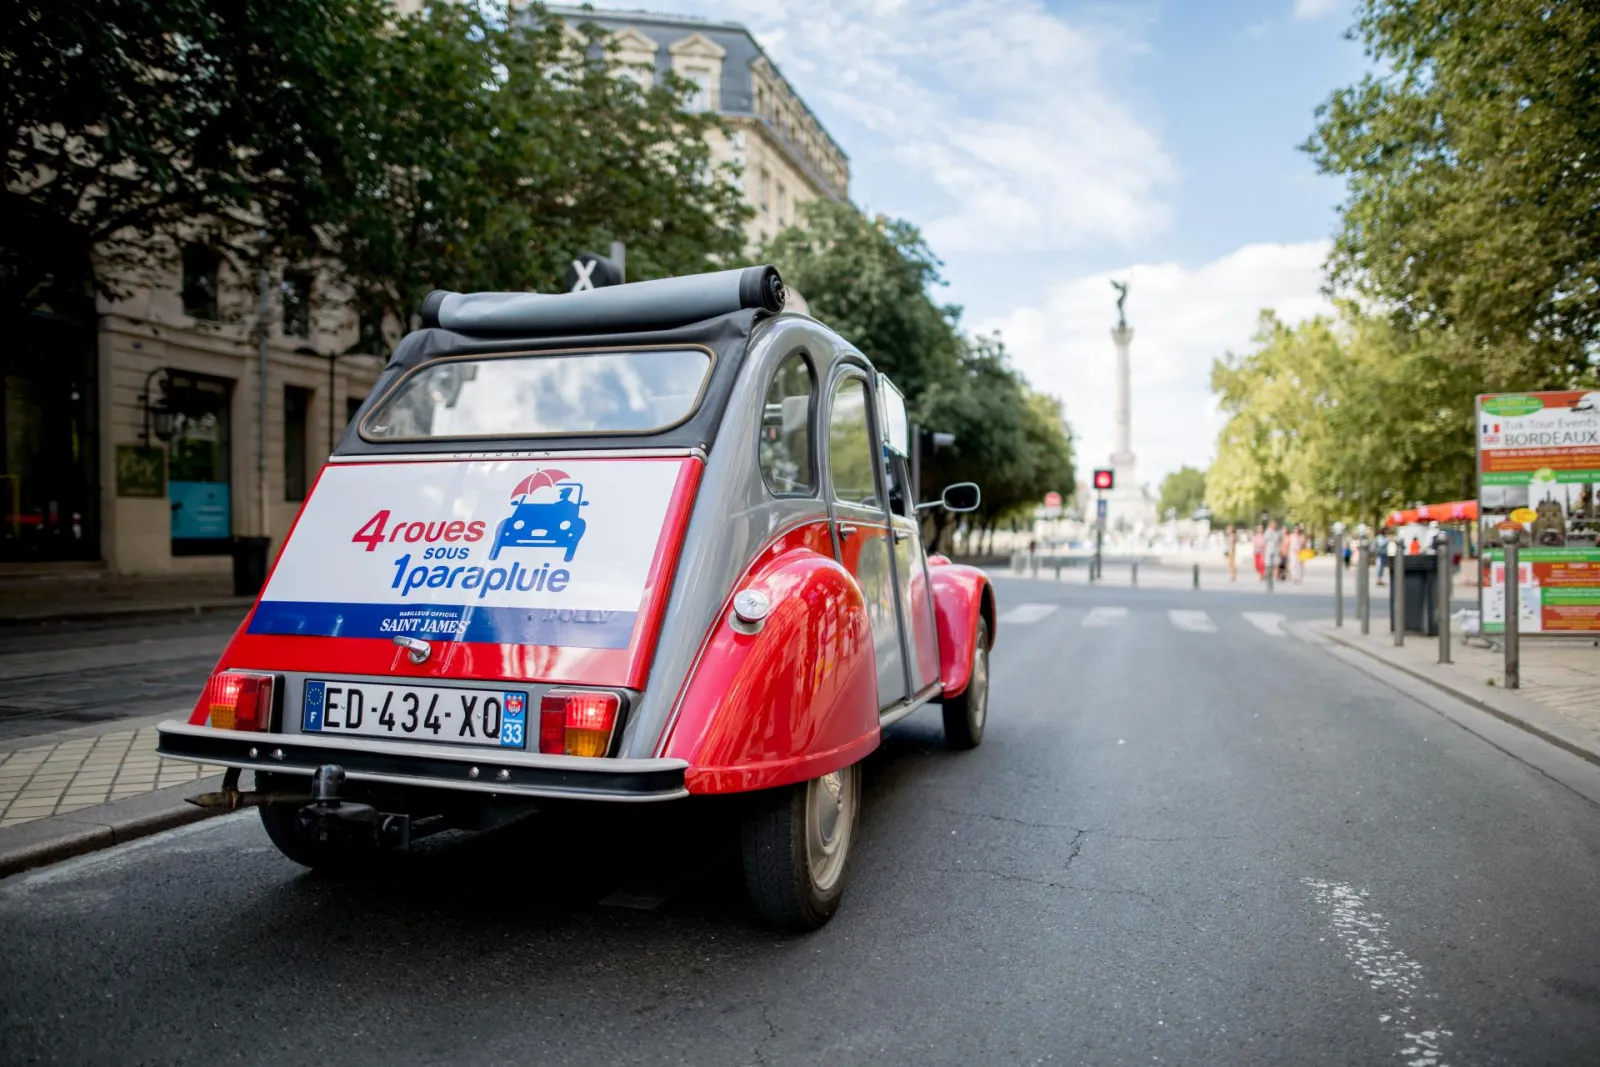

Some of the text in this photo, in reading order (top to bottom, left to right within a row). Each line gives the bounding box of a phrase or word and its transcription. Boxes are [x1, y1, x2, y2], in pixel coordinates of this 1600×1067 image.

[1504, 431, 1598, 446] BORDEAUX
[423, 547, 470, 560] sous
[379, 618, 470, 634] SAINT JAMES
[323, 688, 501, 739] ED-434-XQ
[503, 723, 523, 744] 33
